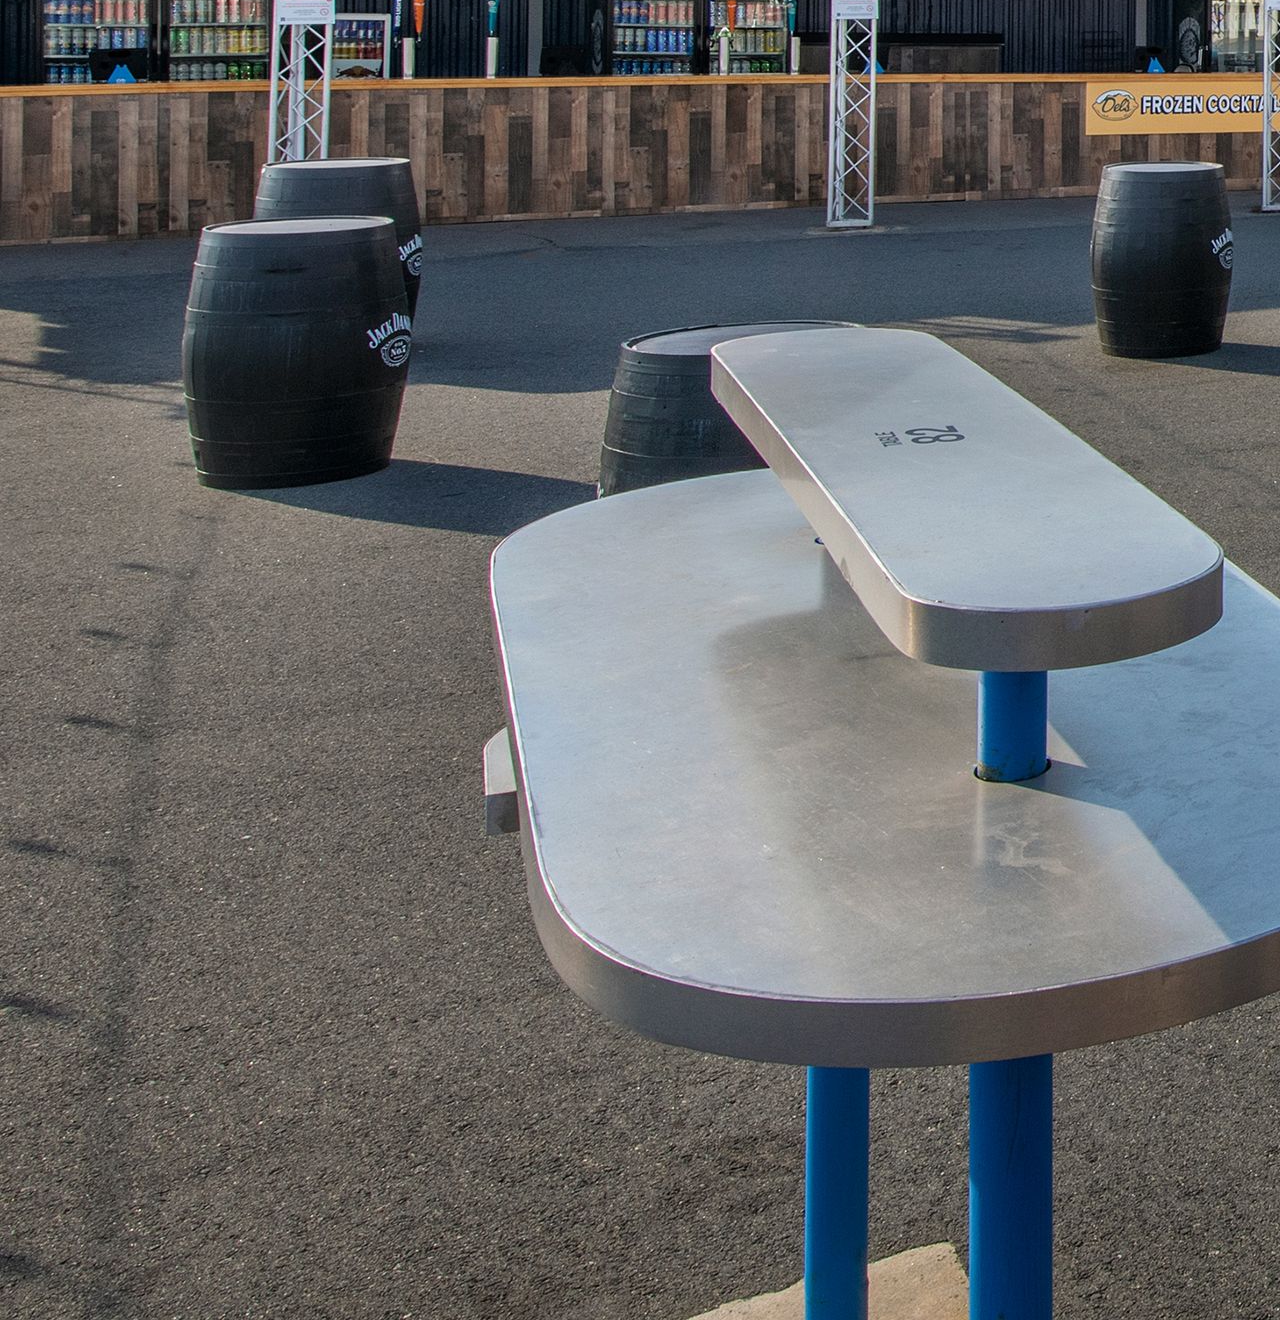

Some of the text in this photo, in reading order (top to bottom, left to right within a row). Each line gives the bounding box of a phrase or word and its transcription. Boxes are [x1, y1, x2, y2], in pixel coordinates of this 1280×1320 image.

[1101, 95, 1131, 114] Del's
[1141, 95, 1204, 114] FROZEN
[367, 319, 392, 349] JACK
[904, 424, 966, 445] 82
